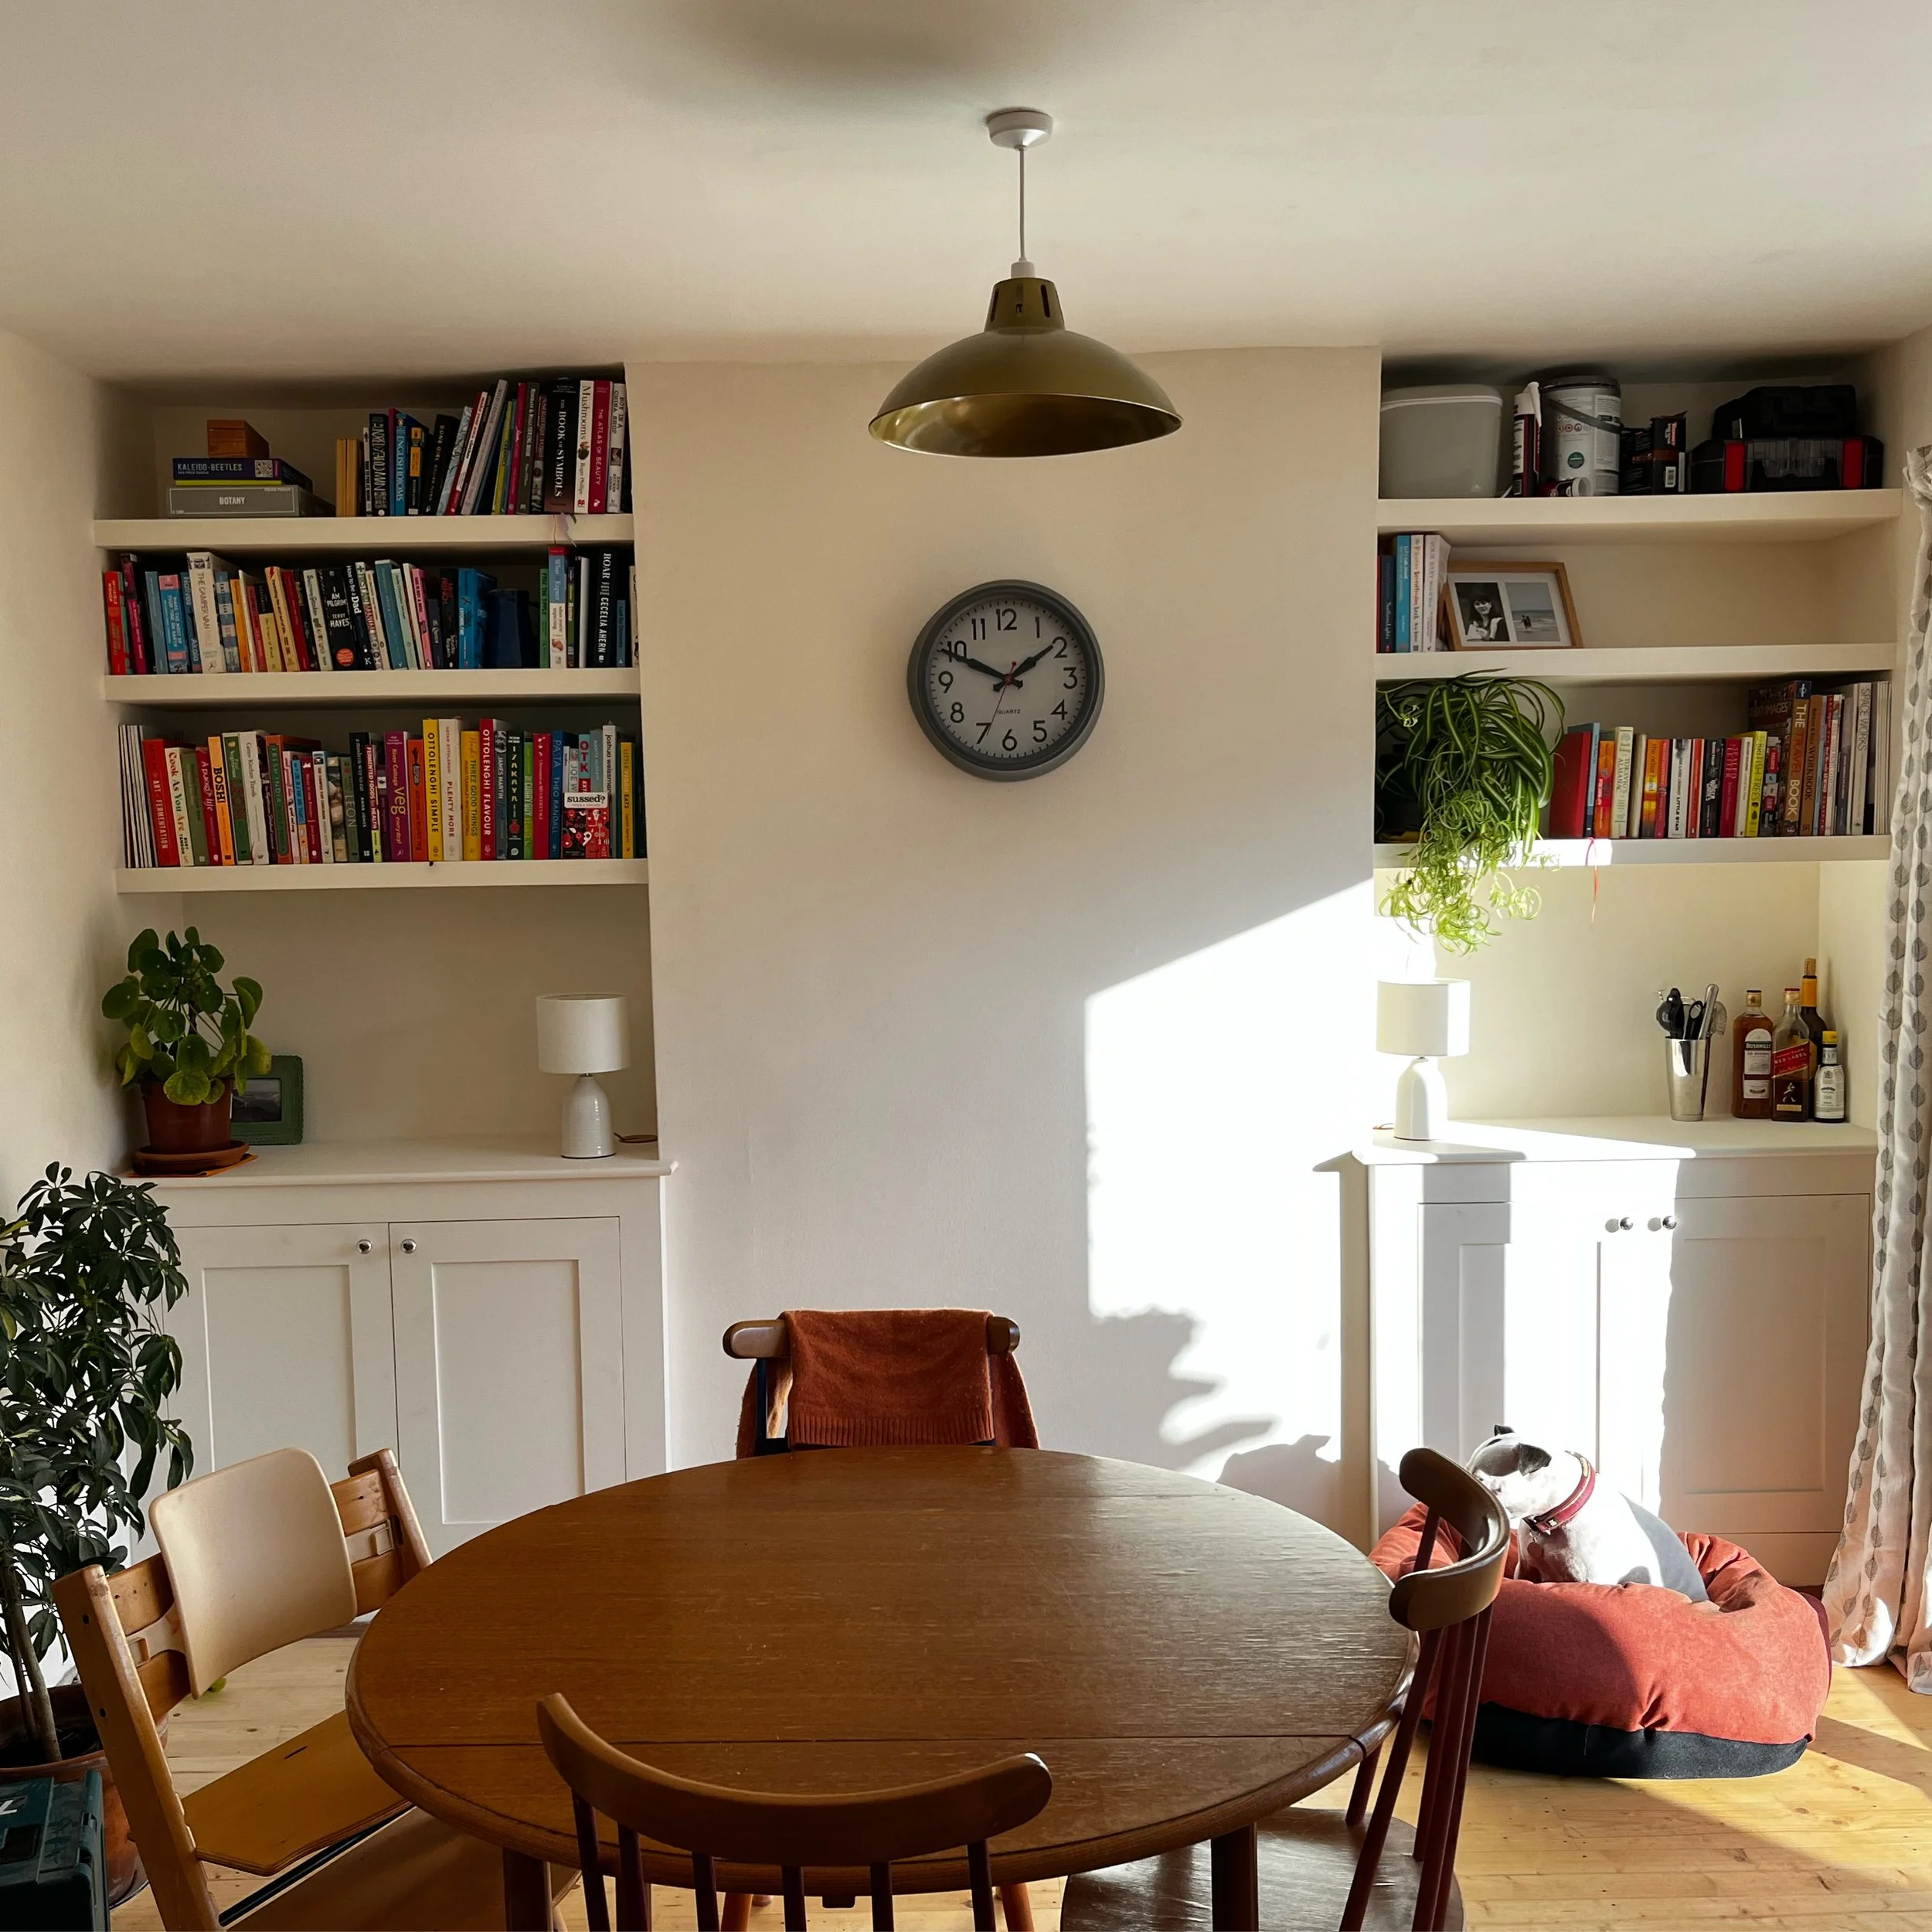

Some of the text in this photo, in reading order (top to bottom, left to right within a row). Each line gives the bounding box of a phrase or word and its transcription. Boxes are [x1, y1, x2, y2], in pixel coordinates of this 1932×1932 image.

[580, 386, 591, 440] Mushrooms
[554, 410, 566, 498] BOOK SYMBOLS
[178, 463, 243, 471] KALEIDO-BEETLES
[594, 456, 603, 486] BEAUTY
[219, 496, 246, 505] BOTANY
[199, 587, 209, 614] CAMPER
[553, 580, 562, 600] Expect
[351, 596, 362, 615] Dad
[597, 553, 612, 653] ROAR CECELIA AHERN
[203, 614, 212, 630] VAN
[328, 618, 350, 629] HAYES
[971, 617, 986, 640] 11
[996, 608, 1017, 631] 12
[1035, 616, 1040, 638] 1
[190, 638, 199, 663] Akala
[947, 640, 967, 662] 10
[1052, 636, 1068, 658] 2
[937, 671, 954, 694] 9
[1063, 667, 1078, 689] 3
[950, 701, 964, 723] 8
[1050, 699, 1068, 720] 4
[1858, 688, 1870, 751] SPACE WORKS
[975, 722, 992, 744] 7
[1002, 729, 1018, 751] 6
[1032, 720, 1048, 742] 5
[246, 742, 254, 760] Green
[1787, 703, 1807, 817] THE TRAVEL BOOK
[248, 759, 257, 780] Kitchen
[366, 747, 375, 780] FERMENTED
[1616, 757, 1625, 791] ALMANAC
[1724, 747, 1733, 779] LETTER
[1730, 747, 1740, 780] SEALED
[1751, 743, 1764, 801] BRITISH TREES
[1804, 747, 1817, 801] WORKBOOK
[168, 751, 186, 832] Cook As You Are
[213, 767, 226, 804] BOSH!
[274, 777, 282, 804] INDIA
[369, 781, 377, 800] FOODS
[427, 732, 439, 834] OTTOLENGHI SIMPLE
[482, 728, 492, 835] OTTOLENGHI FLAVOUR
[552, 740, 563, 835] PASTA THEO RANDALL
[571, 783, 578, 792] W
[1648, 774, 1656, 792] hand
[345, 795, 357, 828] LEON
[390, 786, 407, 816] veg
[525, 782, 534, 818] CURRY GUY
[566, 795, 606, 805] sussed?
[152, 780, 169, 850] ART FERMENTATION
[1788, 1051, 1808, 1062] LABEL
